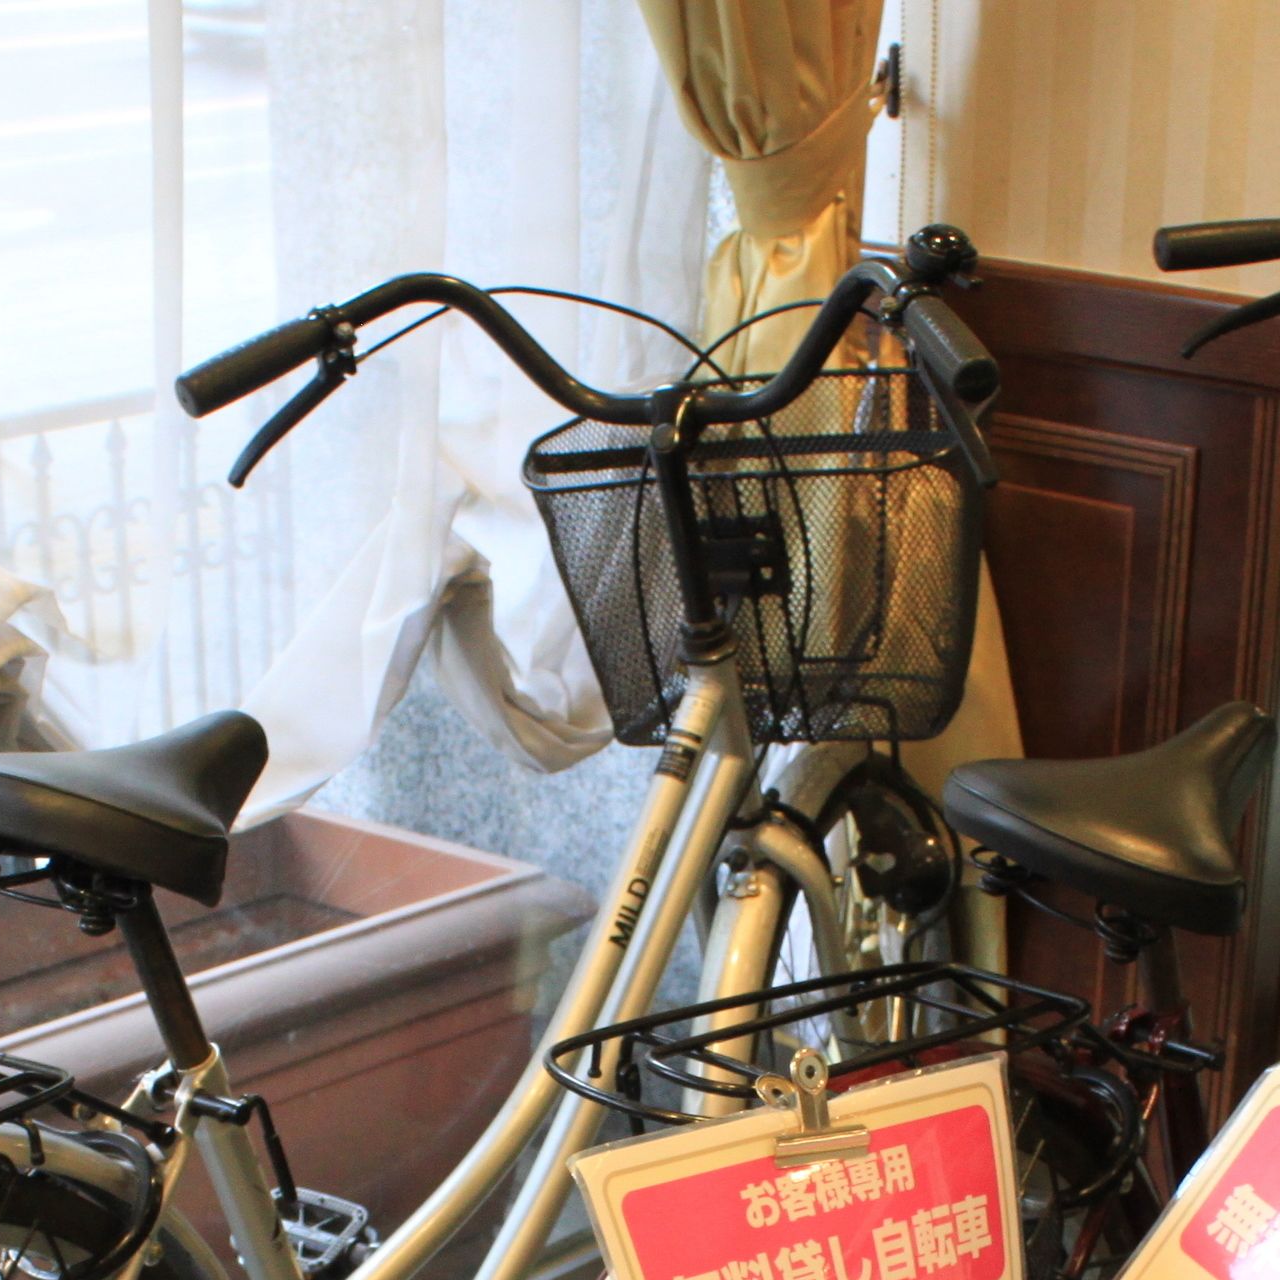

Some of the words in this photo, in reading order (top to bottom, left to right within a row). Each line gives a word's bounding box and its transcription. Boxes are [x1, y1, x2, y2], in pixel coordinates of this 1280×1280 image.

[740, 1144, 917, 1229] お客様専用
